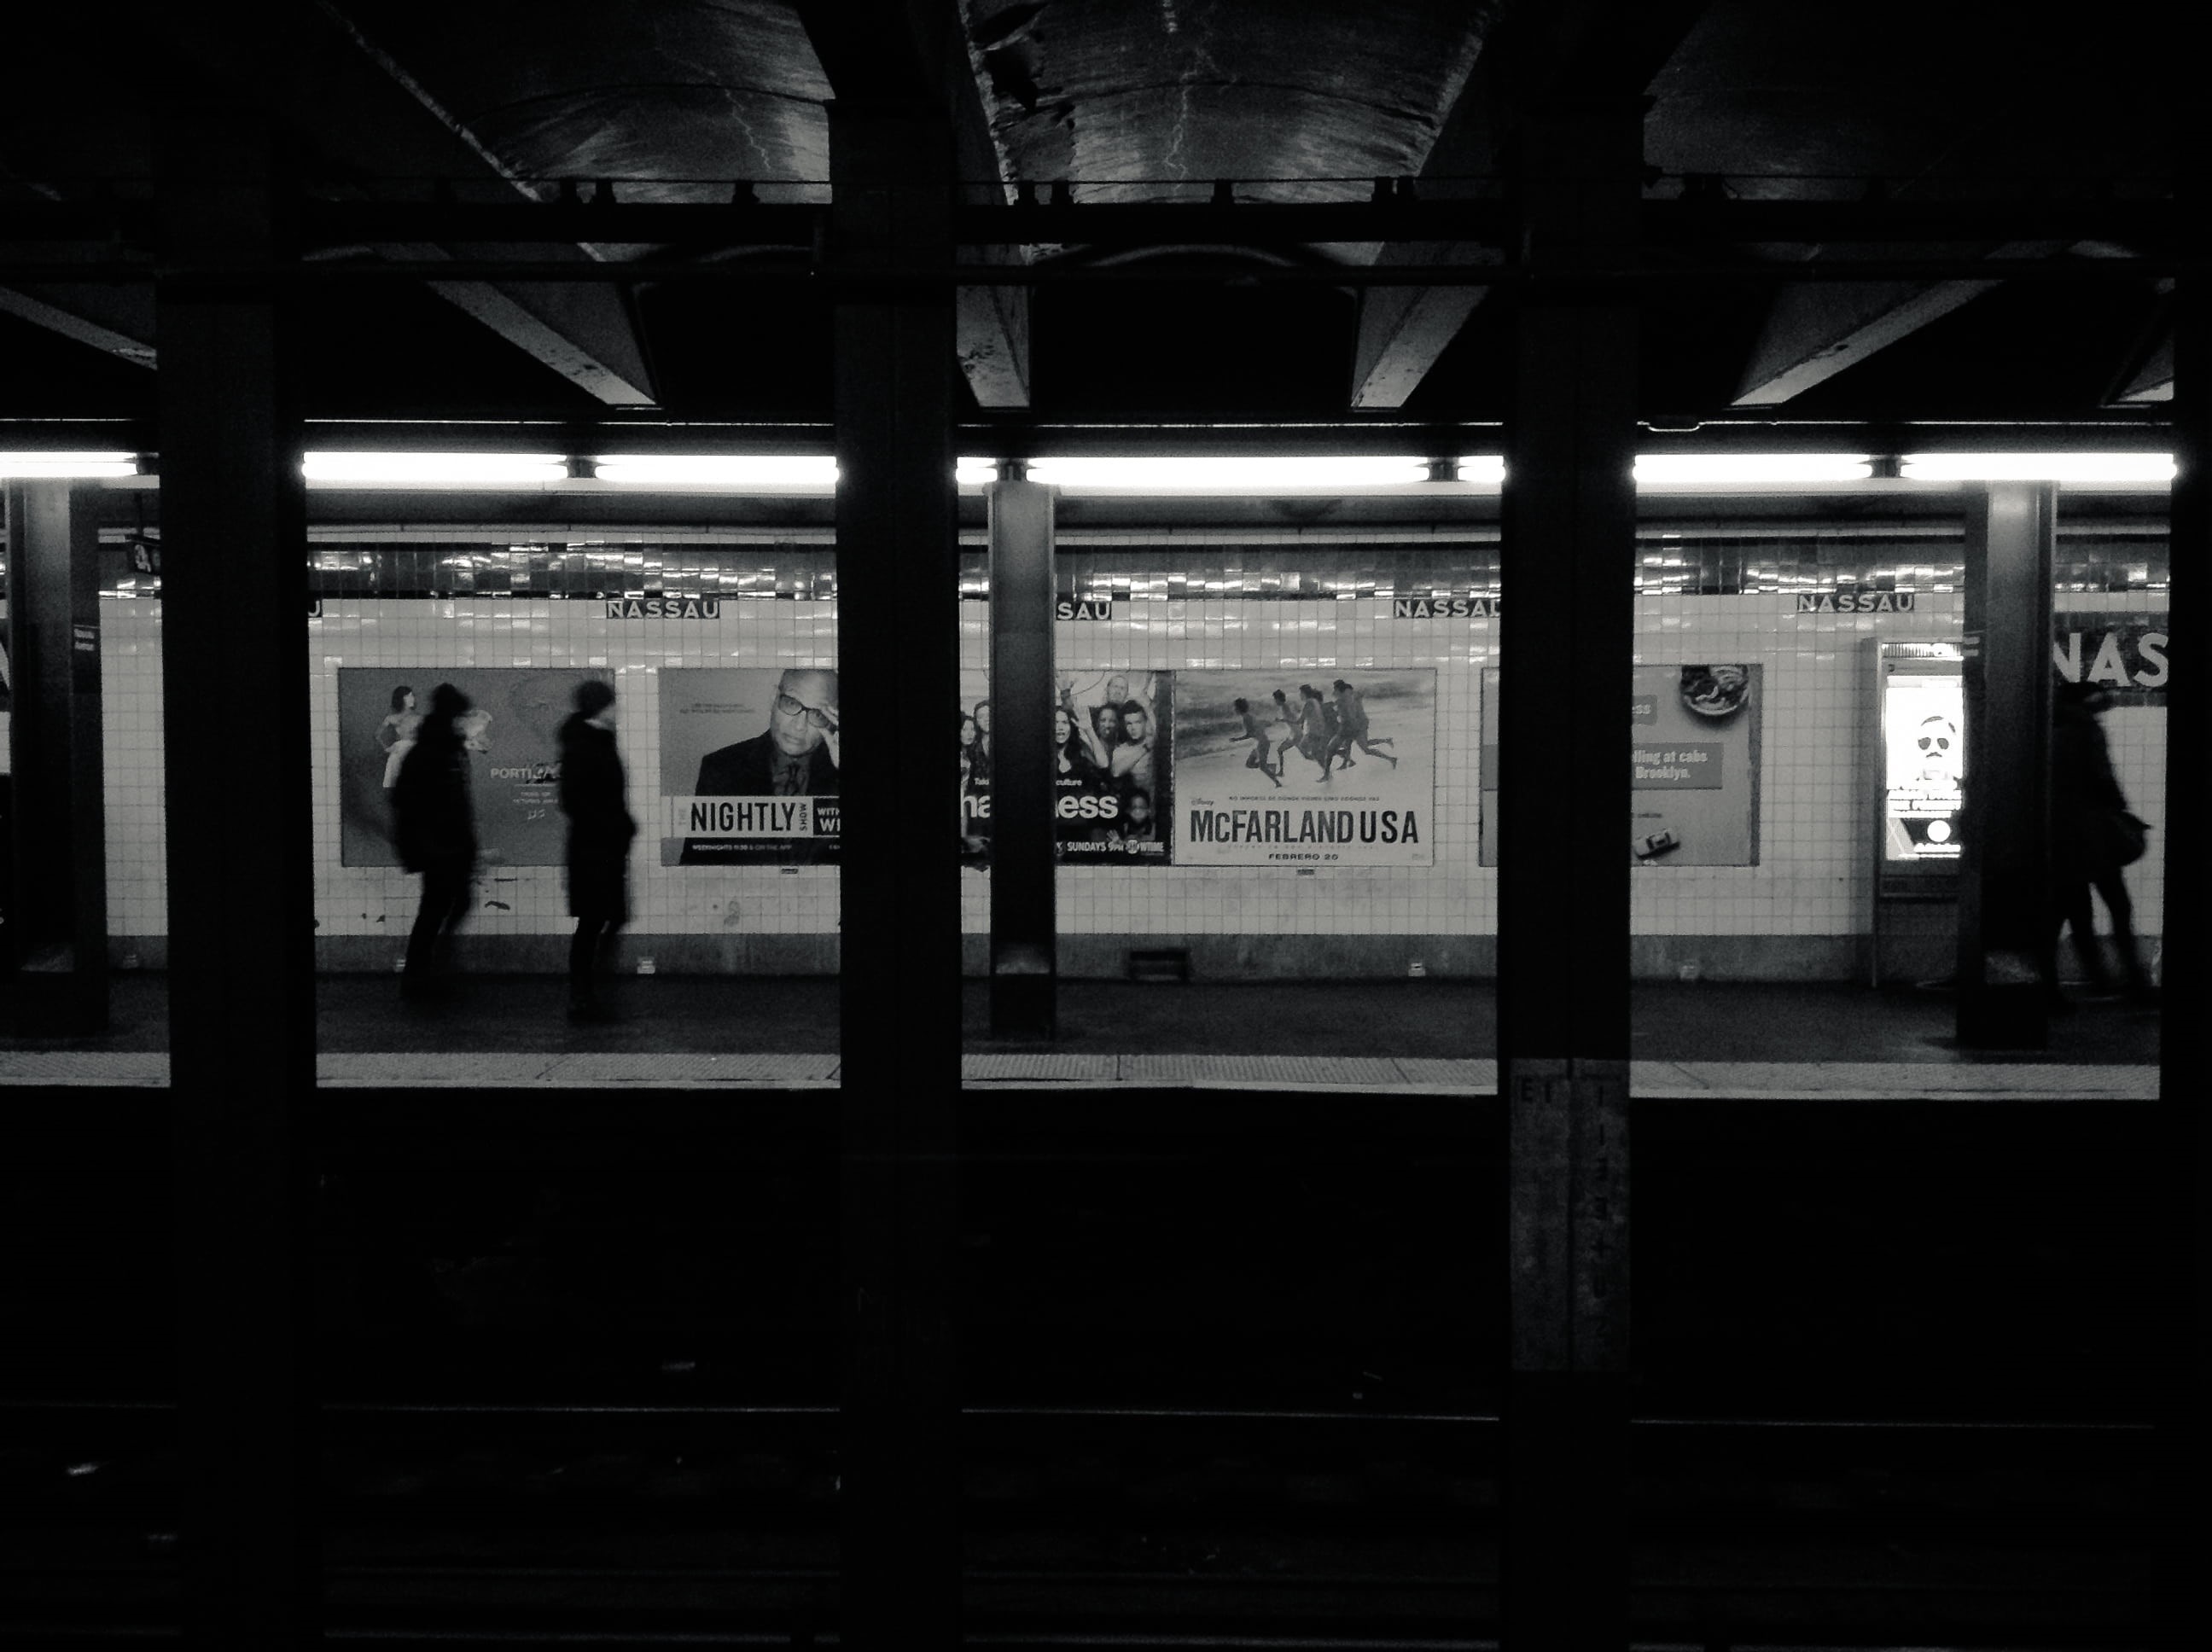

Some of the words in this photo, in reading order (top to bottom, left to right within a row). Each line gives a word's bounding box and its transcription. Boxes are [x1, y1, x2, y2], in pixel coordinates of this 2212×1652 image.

[607, 600, 716, 618] NASSAU
[1057, 602, 1109, 620] SAU
[1798, 595, 1913, 613] NASSAU
[2052, 632, 2168, 687] NAS
[691, 803, 795, 832] NIGHTLY
[1359, 811, 1417, 843] USA
[1067, 841, 1106, 852] SUNDAYS
